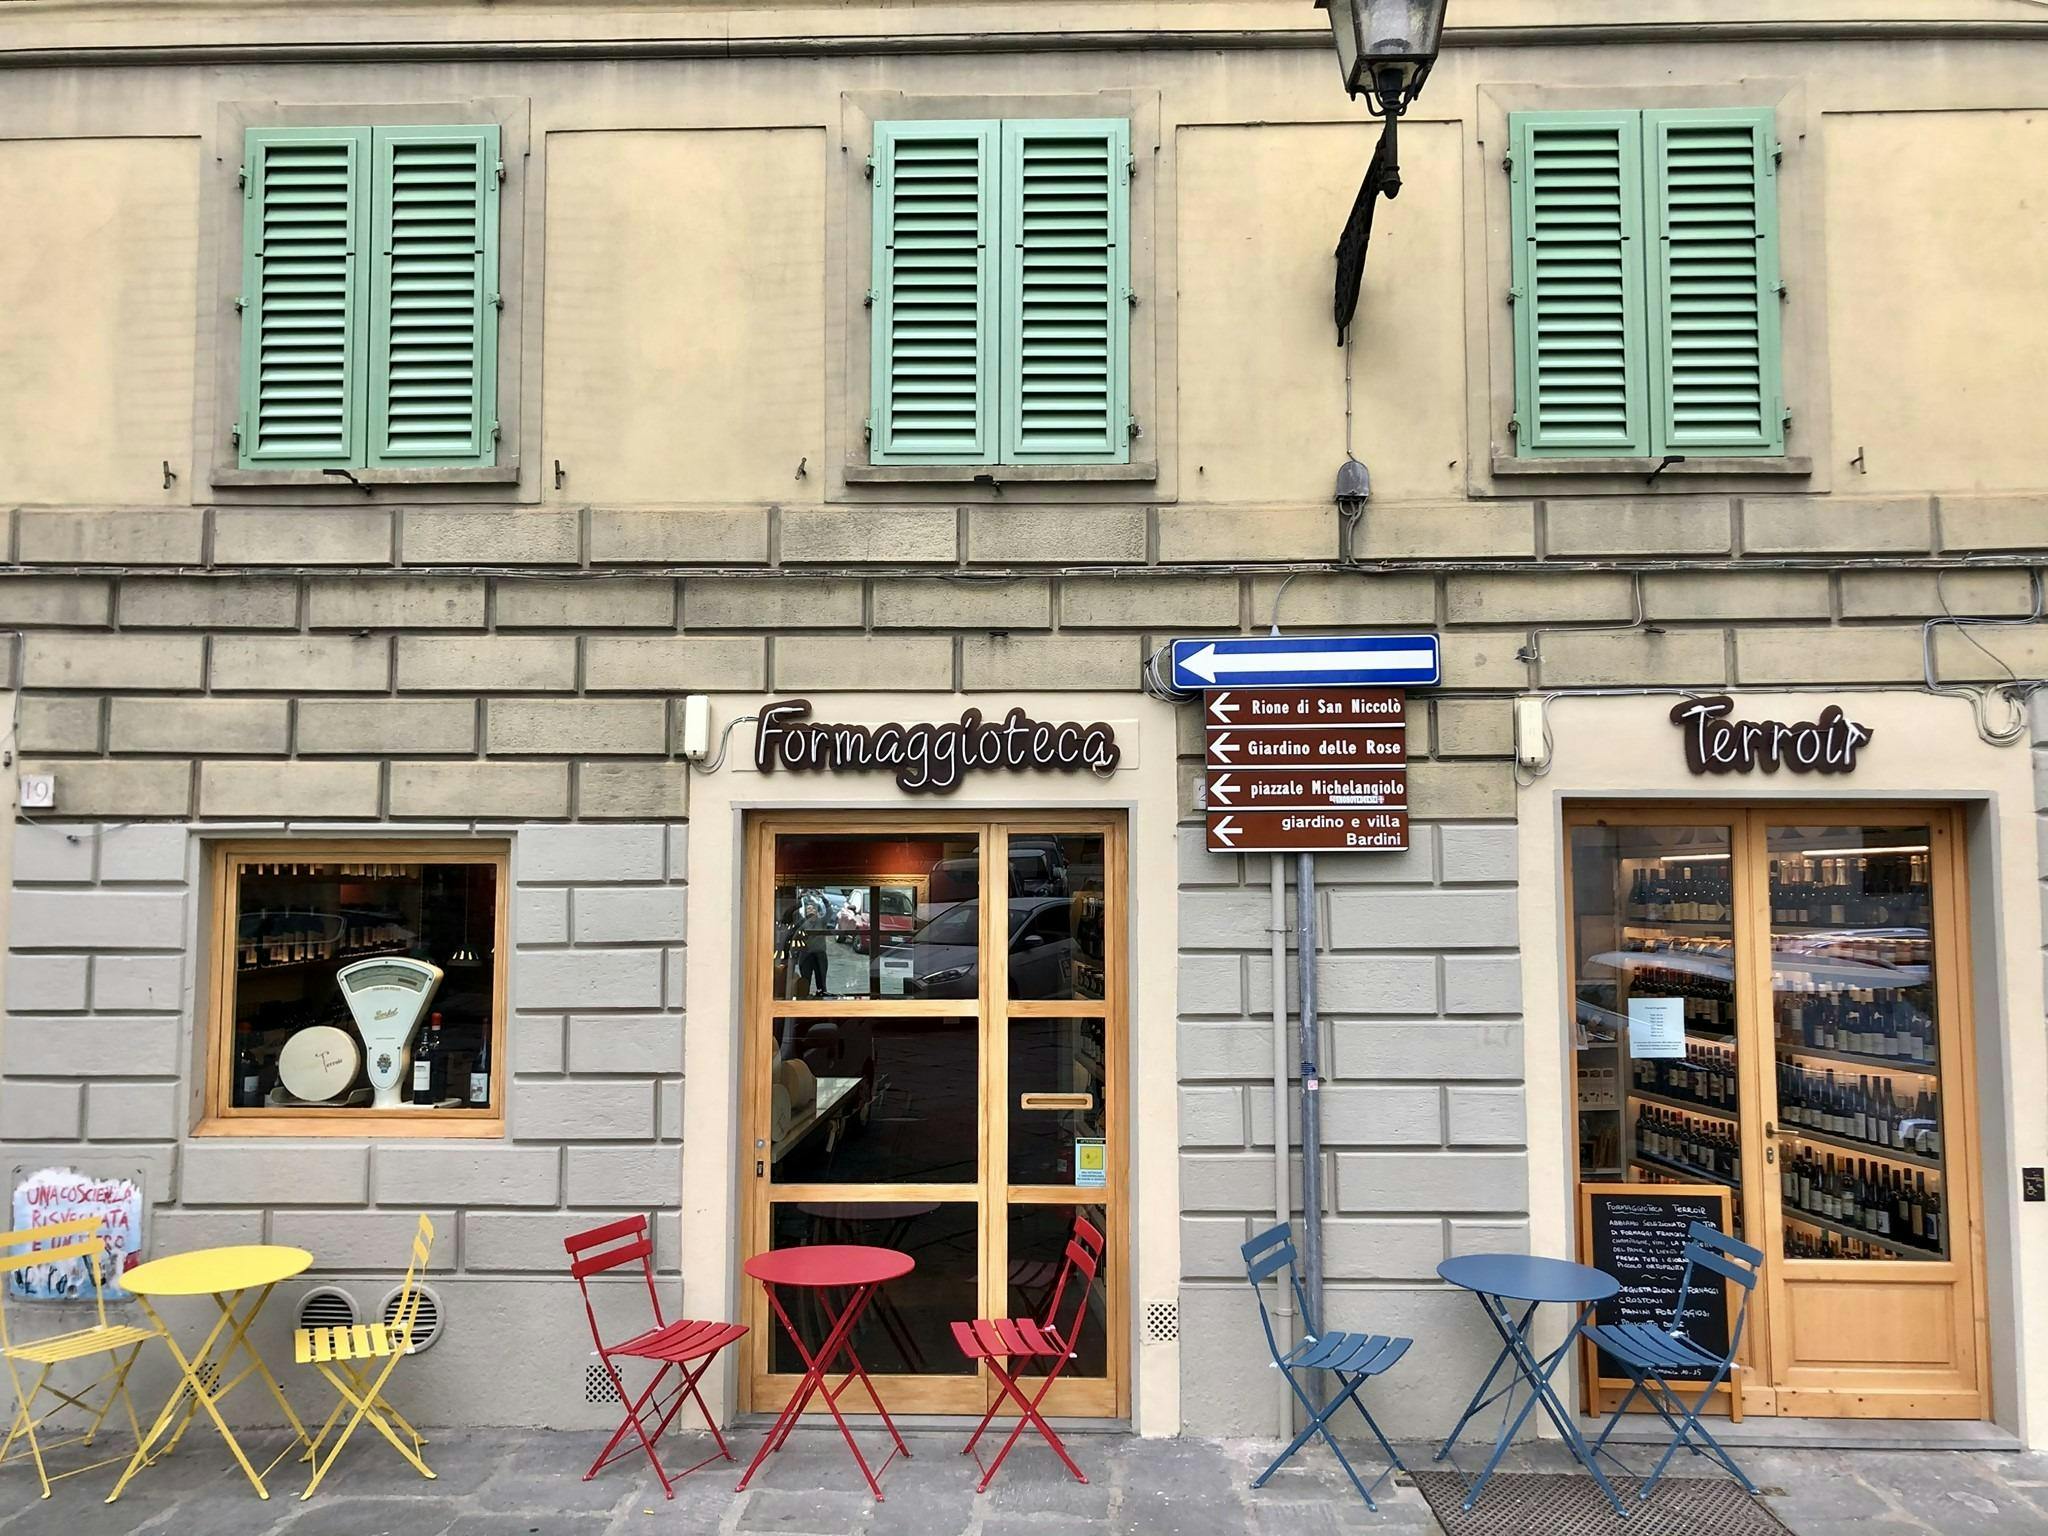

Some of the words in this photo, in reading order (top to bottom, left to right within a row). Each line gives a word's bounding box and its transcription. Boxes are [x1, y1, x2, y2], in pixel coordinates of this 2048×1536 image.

[1252, 699, 1290, 714] Rione
[1297, 699, 1309, 714] di
[1318, 699, 1342, 714] San
[1351, 697, 1401, 714] Niccolò
[1678, 701, 1870, 769] Terroir
[756, 703, 1117, 790] Formaggioteca
[1248, 740, 1310, 755] Giardino
[1319, 740, 1357, 755] delle
[1366, 740, 1401, 754] Rose
[26, 782, 48, 801] 19
[1251, 780, 1304, 798] piazzale
[1311, 779, 1404, 796] Michelangiolo
[1282, 815, 1344, 831] giardino
[1351, 819, 1360, 828] e
[1367, 815, 1401, 828] villa
[1346, 833, 1401, 846] Bardini
